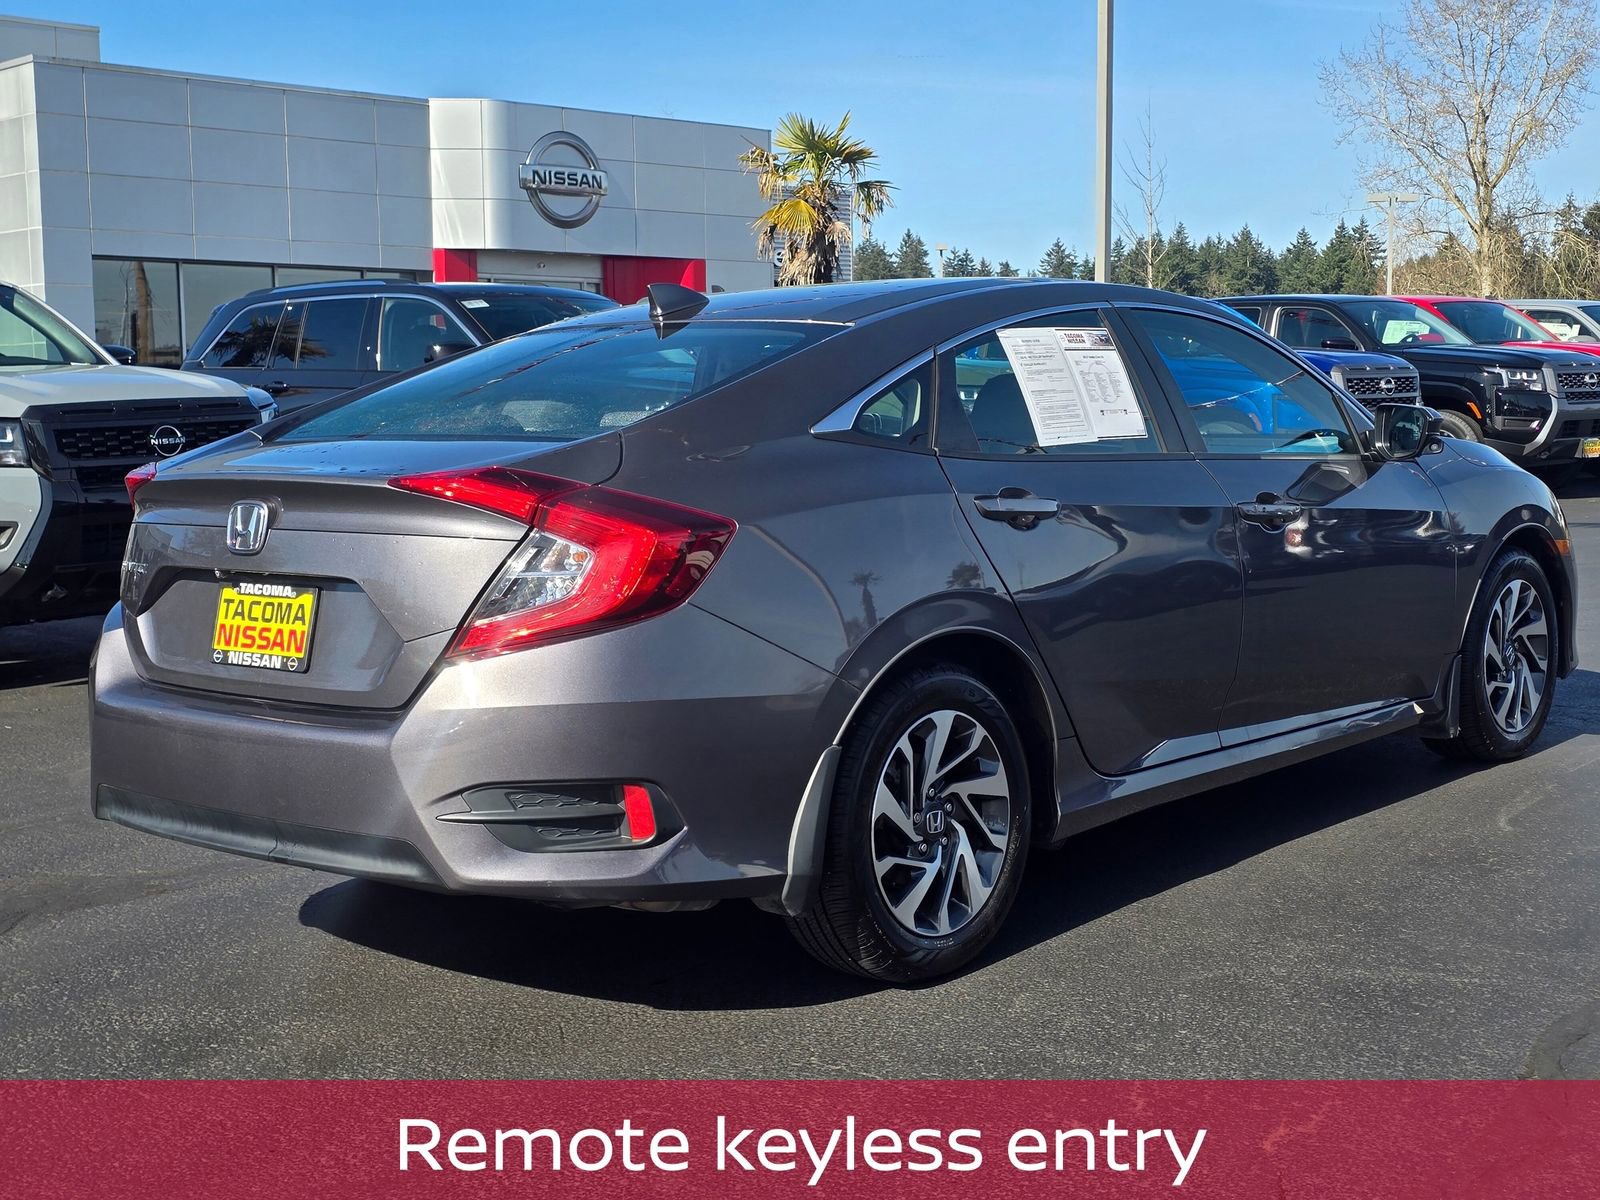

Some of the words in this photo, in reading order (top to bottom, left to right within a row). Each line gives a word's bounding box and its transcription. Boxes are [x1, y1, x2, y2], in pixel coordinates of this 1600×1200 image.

[532, 169, 603, 190] NISSAN
[150, 437, 186, 445] NISSAN
[239, 582, 293, 598] TACOMA
[223, 598, 306, 626] TACOMA
[216, 623, 306, 654] NISSAN
[227, 651, 282, 669] NISSAN
